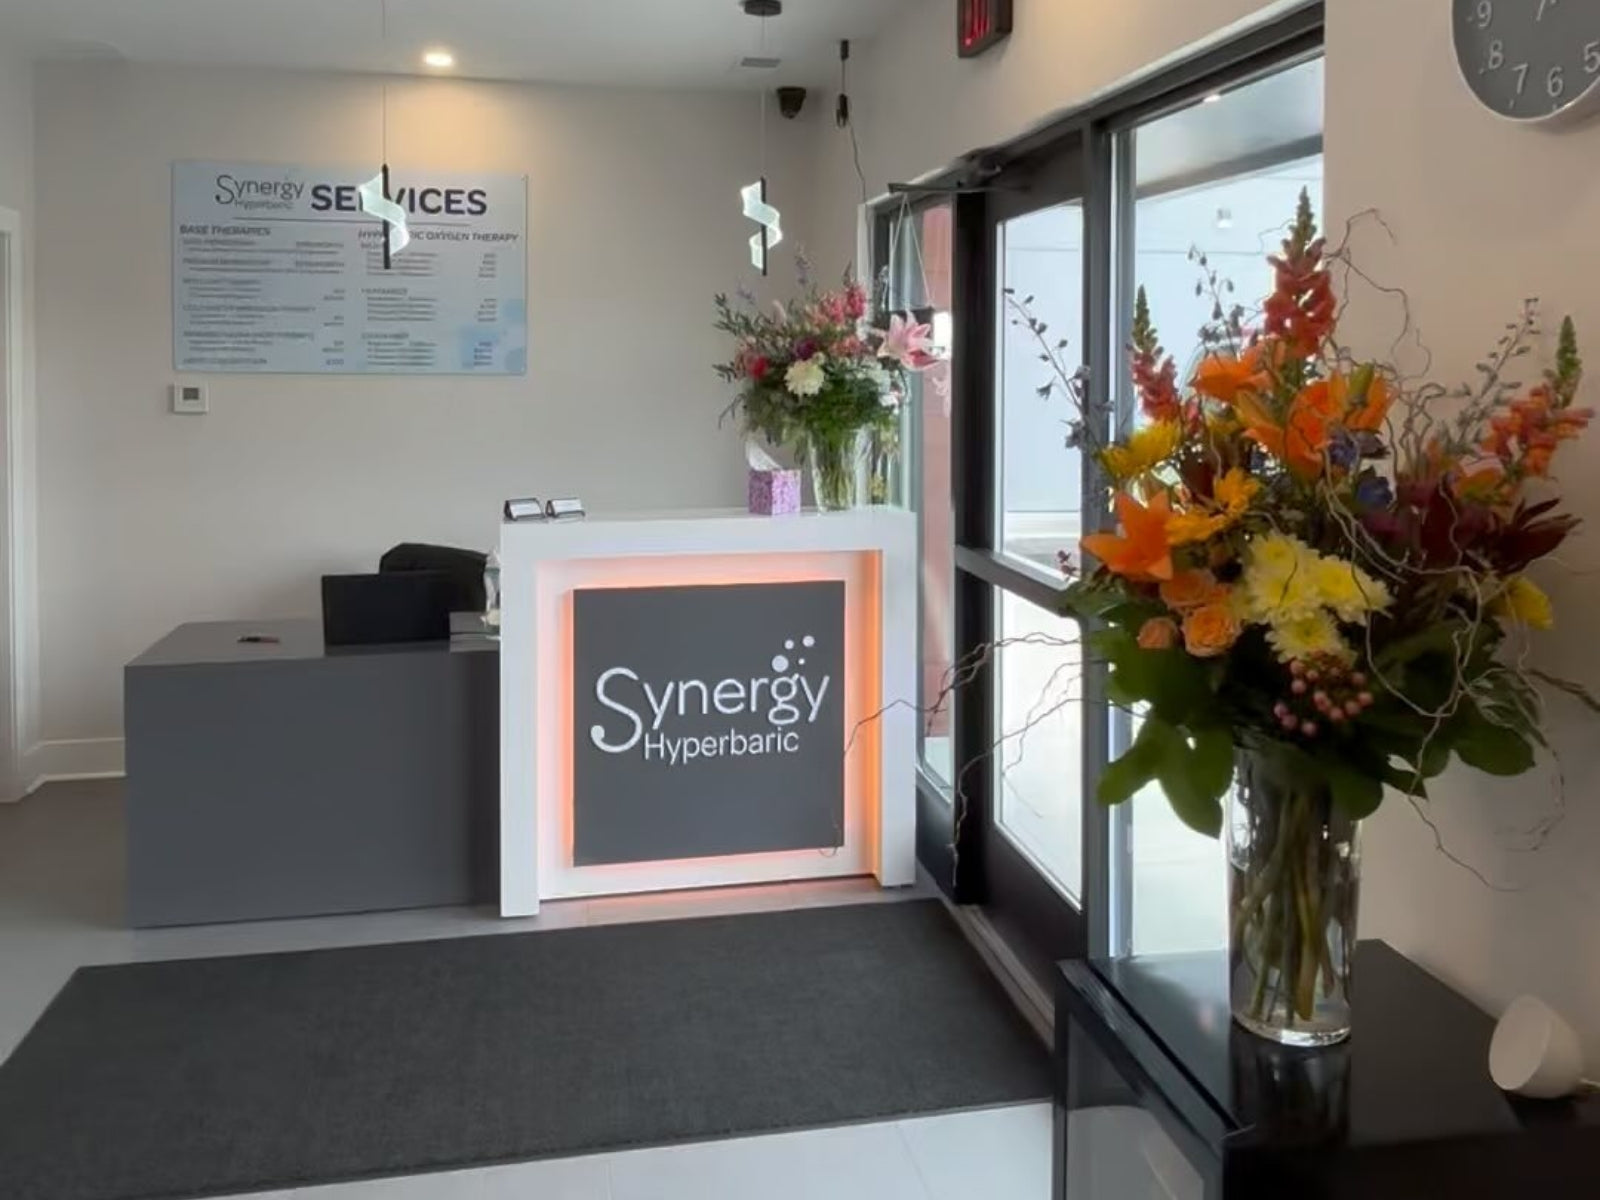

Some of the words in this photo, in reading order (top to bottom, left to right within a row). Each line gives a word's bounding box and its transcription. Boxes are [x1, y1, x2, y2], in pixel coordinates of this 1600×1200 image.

[1477, 0, 1492, 28] 9
[1488, 39, 1504, 70] 8
[1583, 40, 1600, 73] 5
[1511, 62, 1528, 94] 7
[1547, 66, 1563, 97] 6
[214, 174, 305, 205] Synergy
[311, 184, 488, 216] SEVICES
[179, 224, 208, 235] BASE
[211, 225, 271, 237] THERAPIES
[426, 231, 469, 241] OXYGEN
[472, 231, 519, 242] THERAPY
[590, 667, 830, 753] Synergy
[643, 726, 800, 766] Hyperbaric
